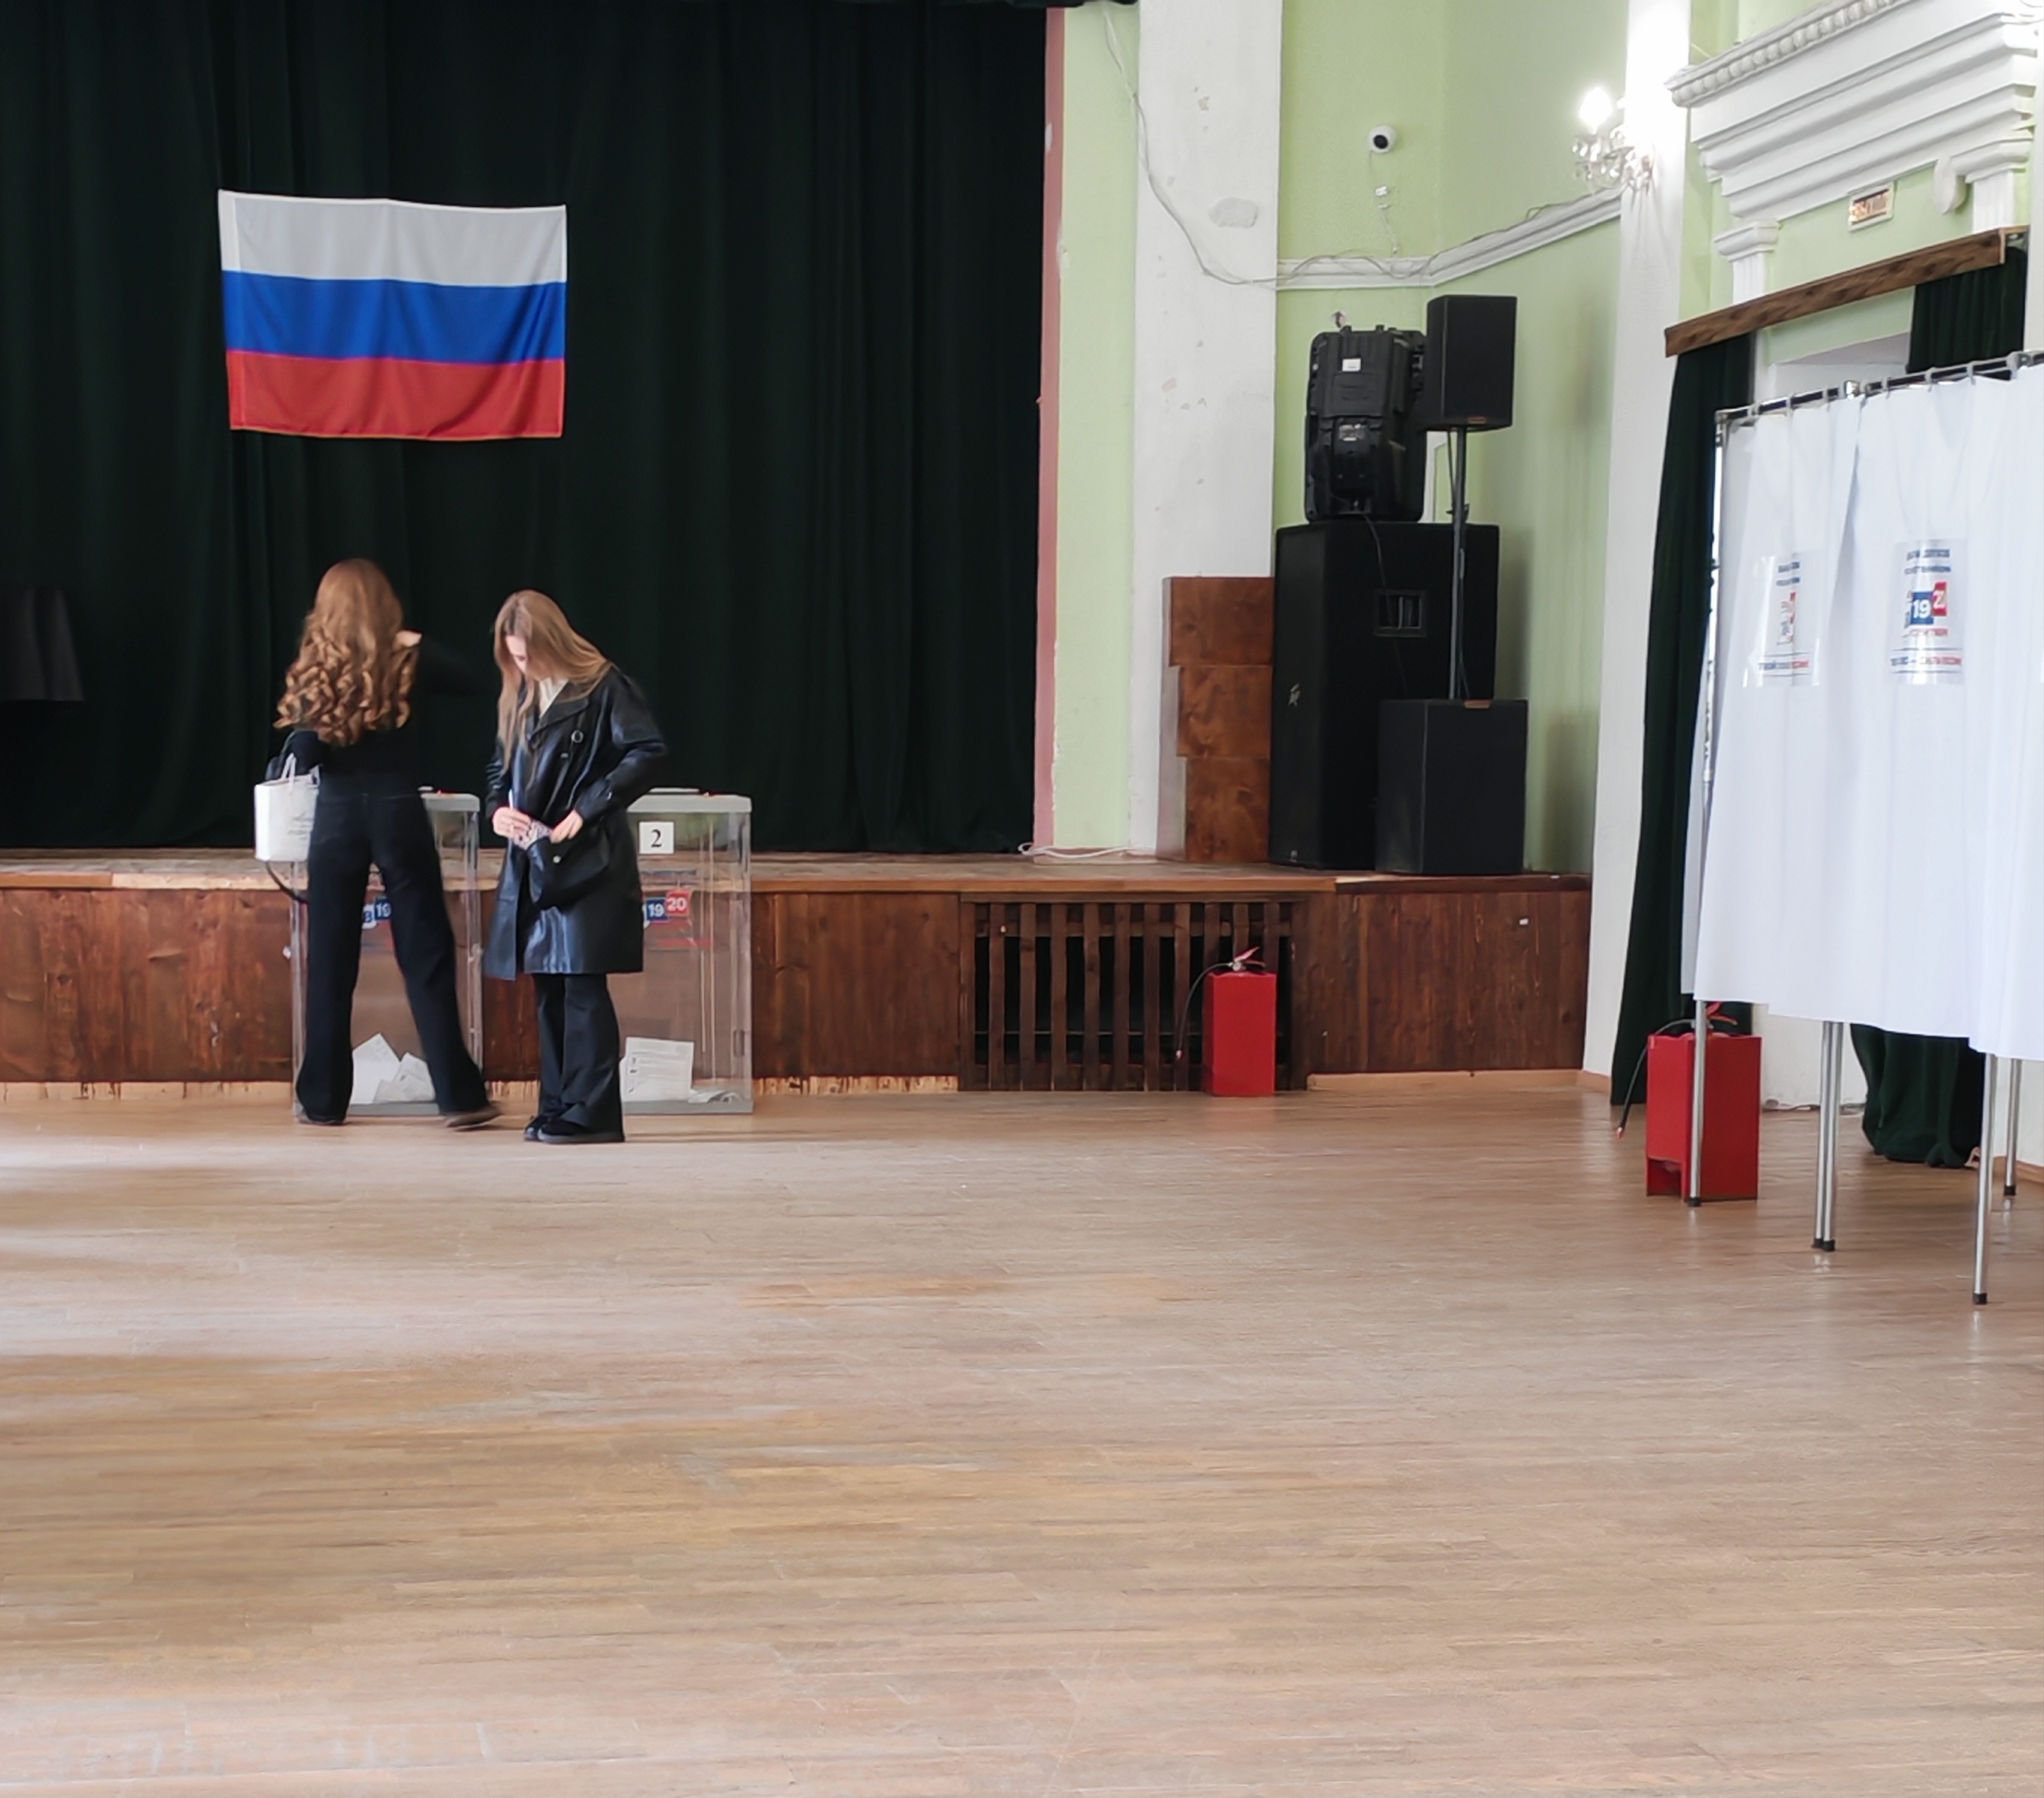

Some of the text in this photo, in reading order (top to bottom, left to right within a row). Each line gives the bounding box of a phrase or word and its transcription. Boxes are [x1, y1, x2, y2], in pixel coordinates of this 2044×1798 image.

[1913, 590, 1946, 618] 19 2
[651, 829, 662, 848] 2
[376, 902, 392, 918] 19
[648, 897, 687, 917] 19 20
